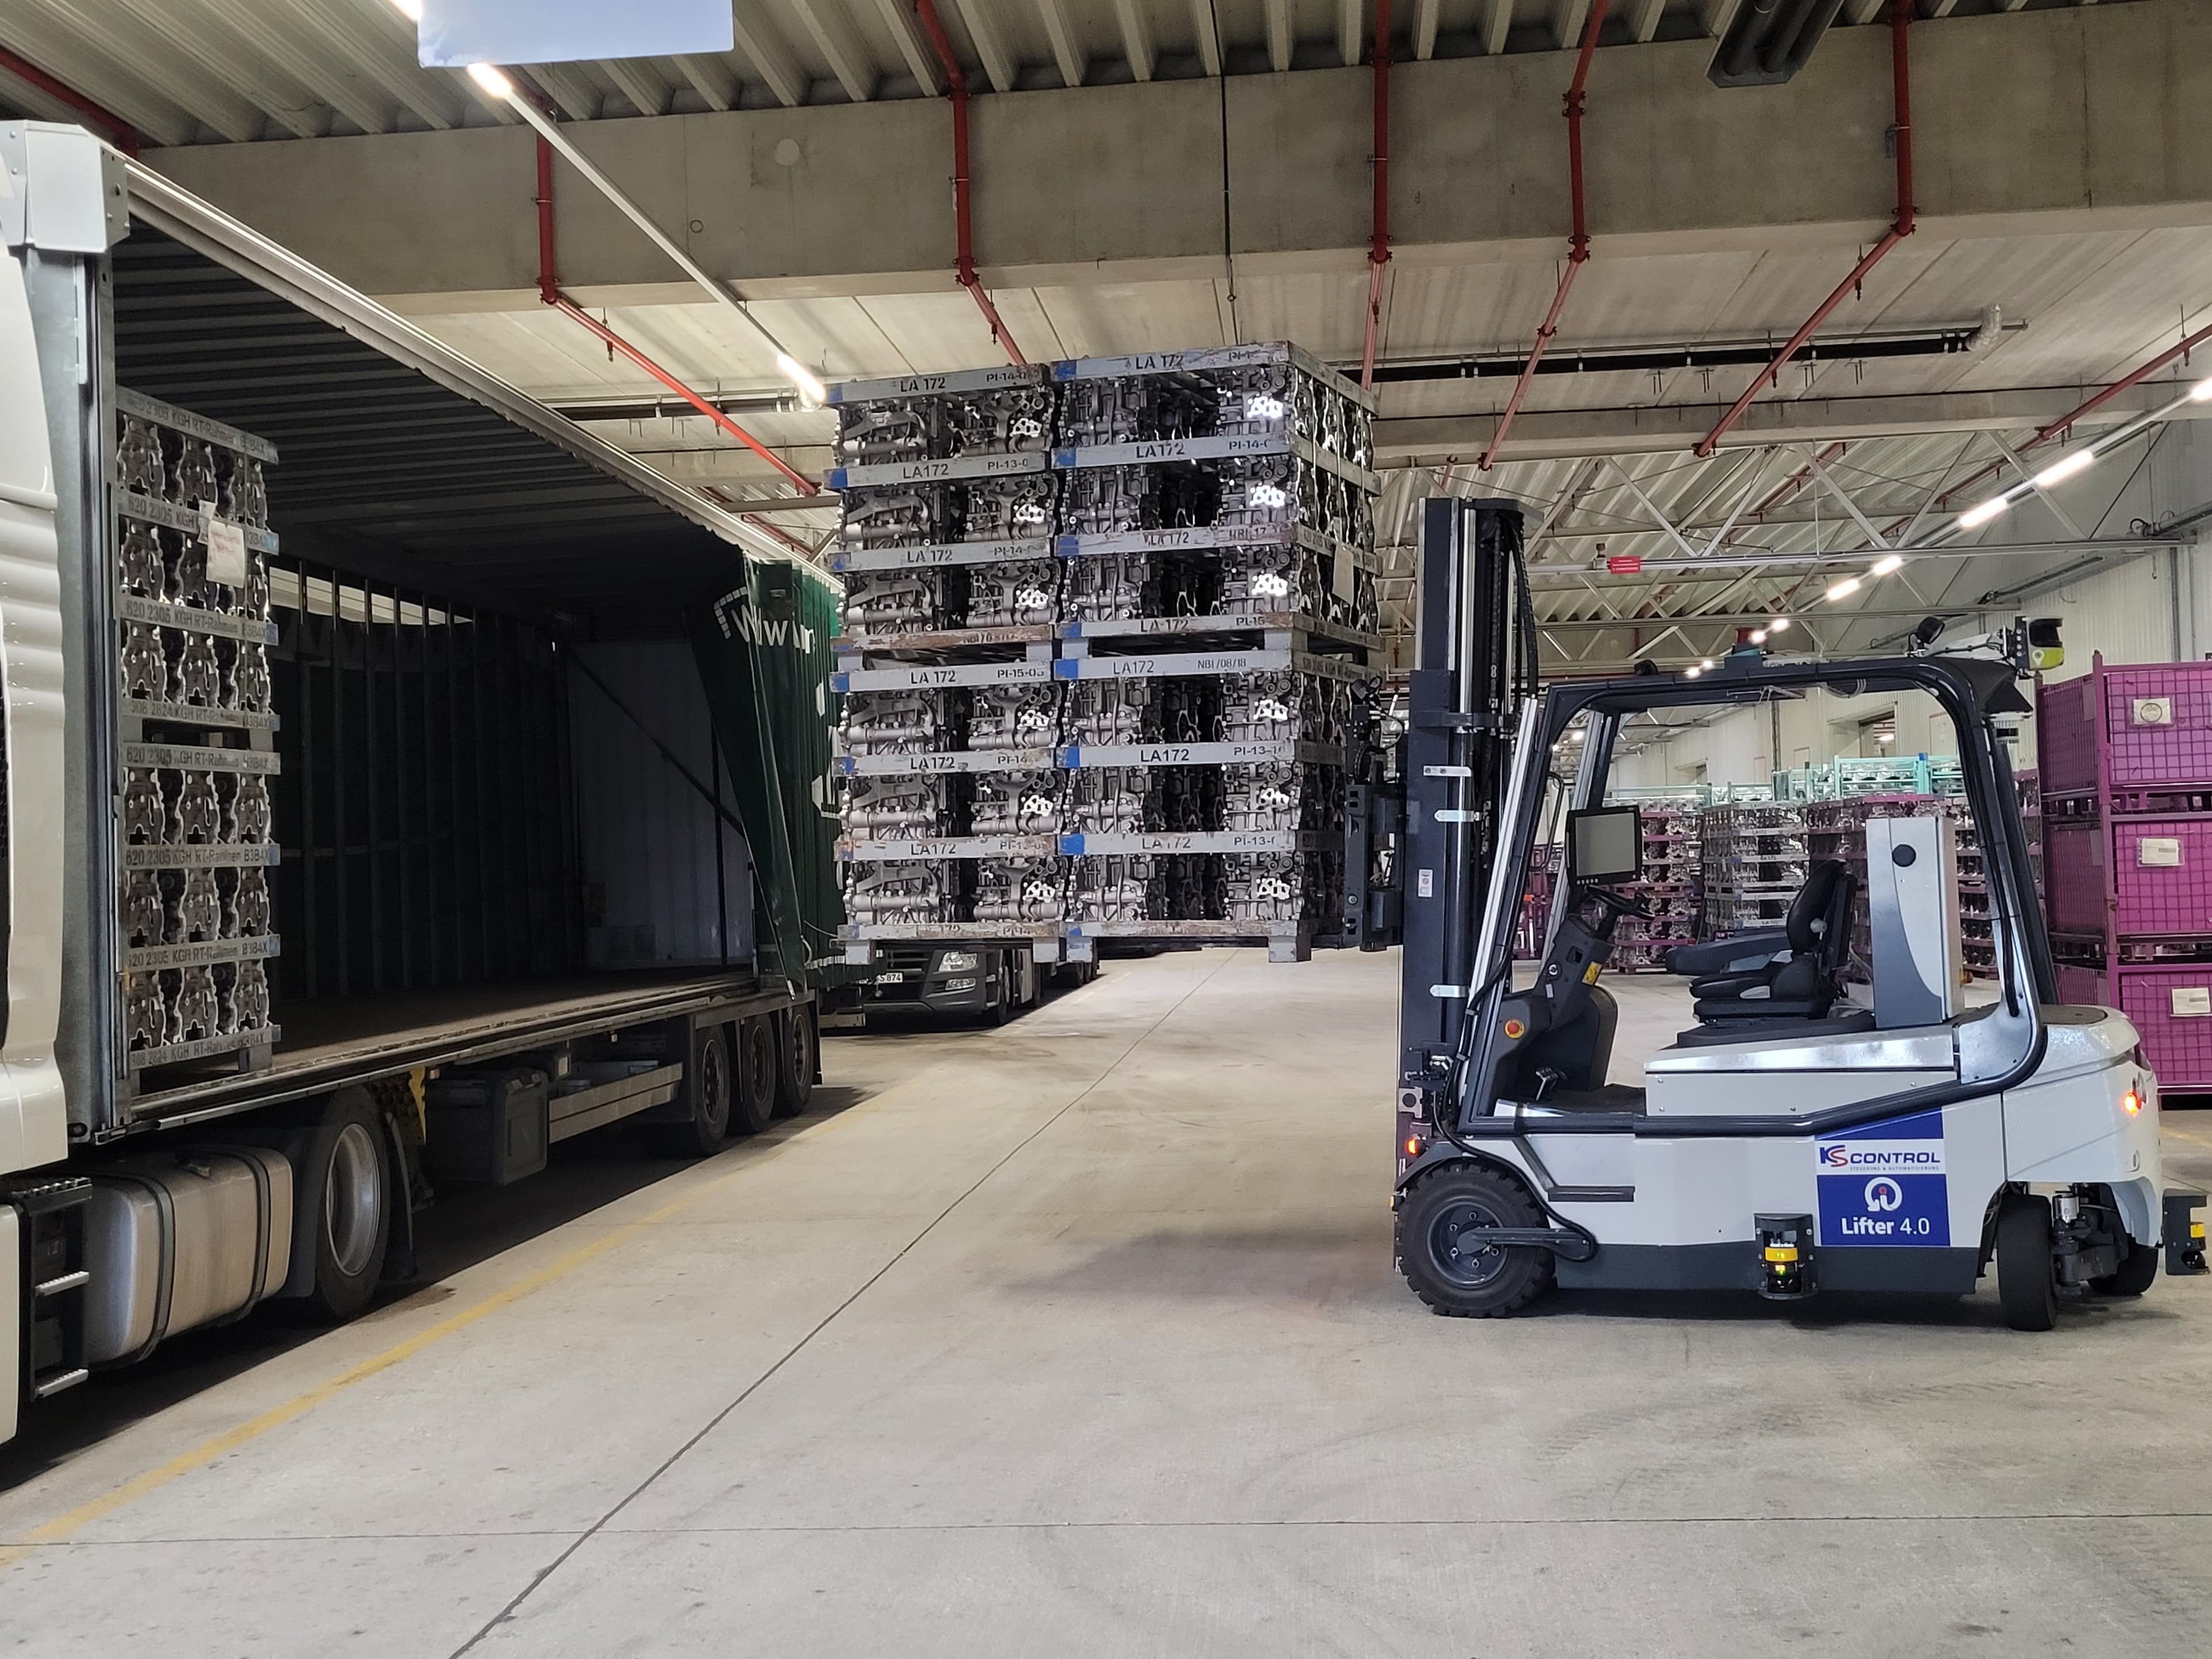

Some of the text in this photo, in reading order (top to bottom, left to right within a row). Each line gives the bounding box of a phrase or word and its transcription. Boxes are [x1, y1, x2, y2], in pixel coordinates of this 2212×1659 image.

[1136, 354, 1184, 369] LA 172
[900, 377, 945, 392] LA 172
[907, 550, 953, 563] LA 172
[127, 602, 145, 618] 620
[147, 604, 171, 624] 2305
[175, 608, 192, 626] KGH
[1113, 660, 1154, 675] LA172
[911, 671, 956, 684] LA 172
[175, 704, 193, 719] KGH
[127, 747, 145, 763] 620
[1141, 749, 1190, 762] LA172
[126, 850, 145, 866] 620
[147, 850, 171, 865] 2305
[172, 849, 191, 864] KGH
[171, 1046, 189, 1059] KGH
[1850, 1152, 1941, 1164] CONTROL
[1841, 1217, 1930, 1235] Lifter 4.0
